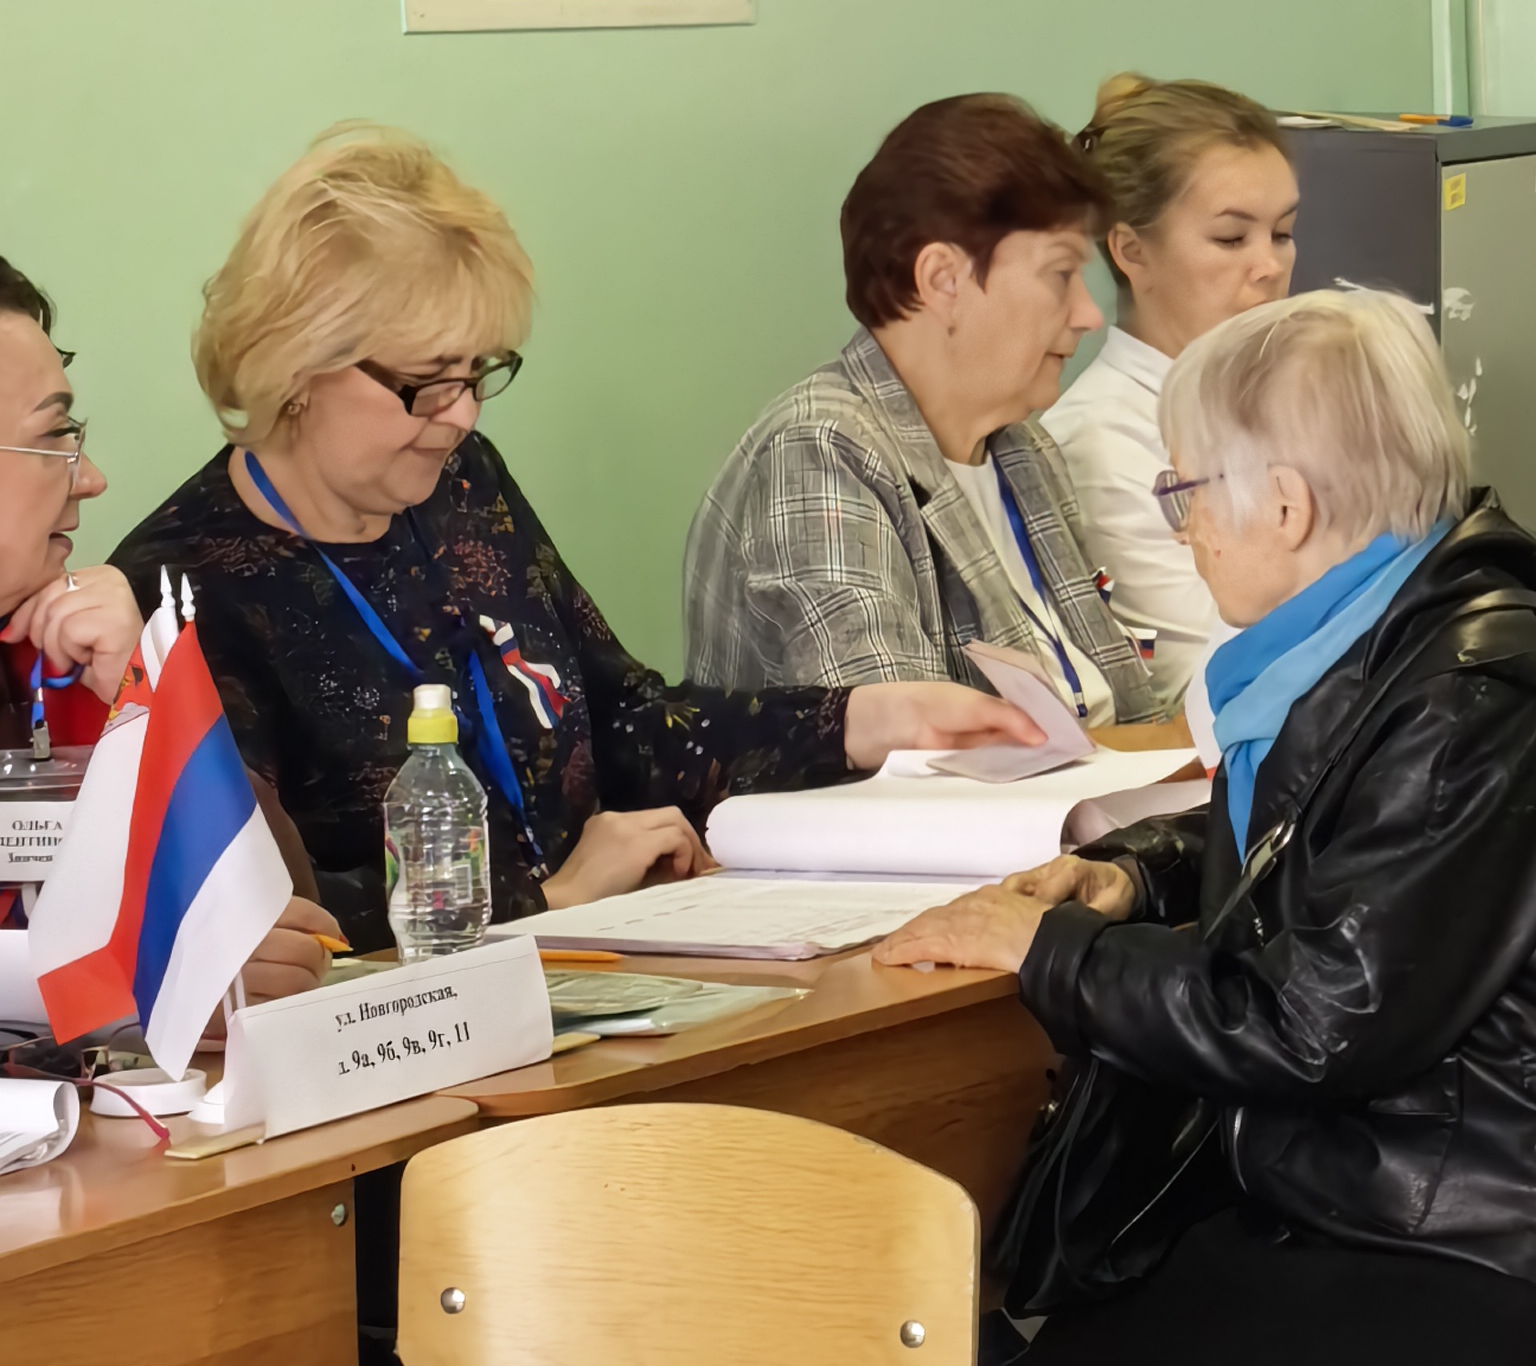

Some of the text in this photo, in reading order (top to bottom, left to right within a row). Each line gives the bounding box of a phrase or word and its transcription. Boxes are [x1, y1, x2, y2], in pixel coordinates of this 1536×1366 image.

[11, 819, 63, 831] ОЛЬГА
[335, 985, 458, 1033] ул. Новгородская,
[351, 1050, 376, 1070] 9а,
[377, 1040, 401, 1063] 9б,
[402, 1036, 426, 1057] 9в,
[428, 1029, 451, 1051] 9г,
[454, 1021, 471, 1043] 11
